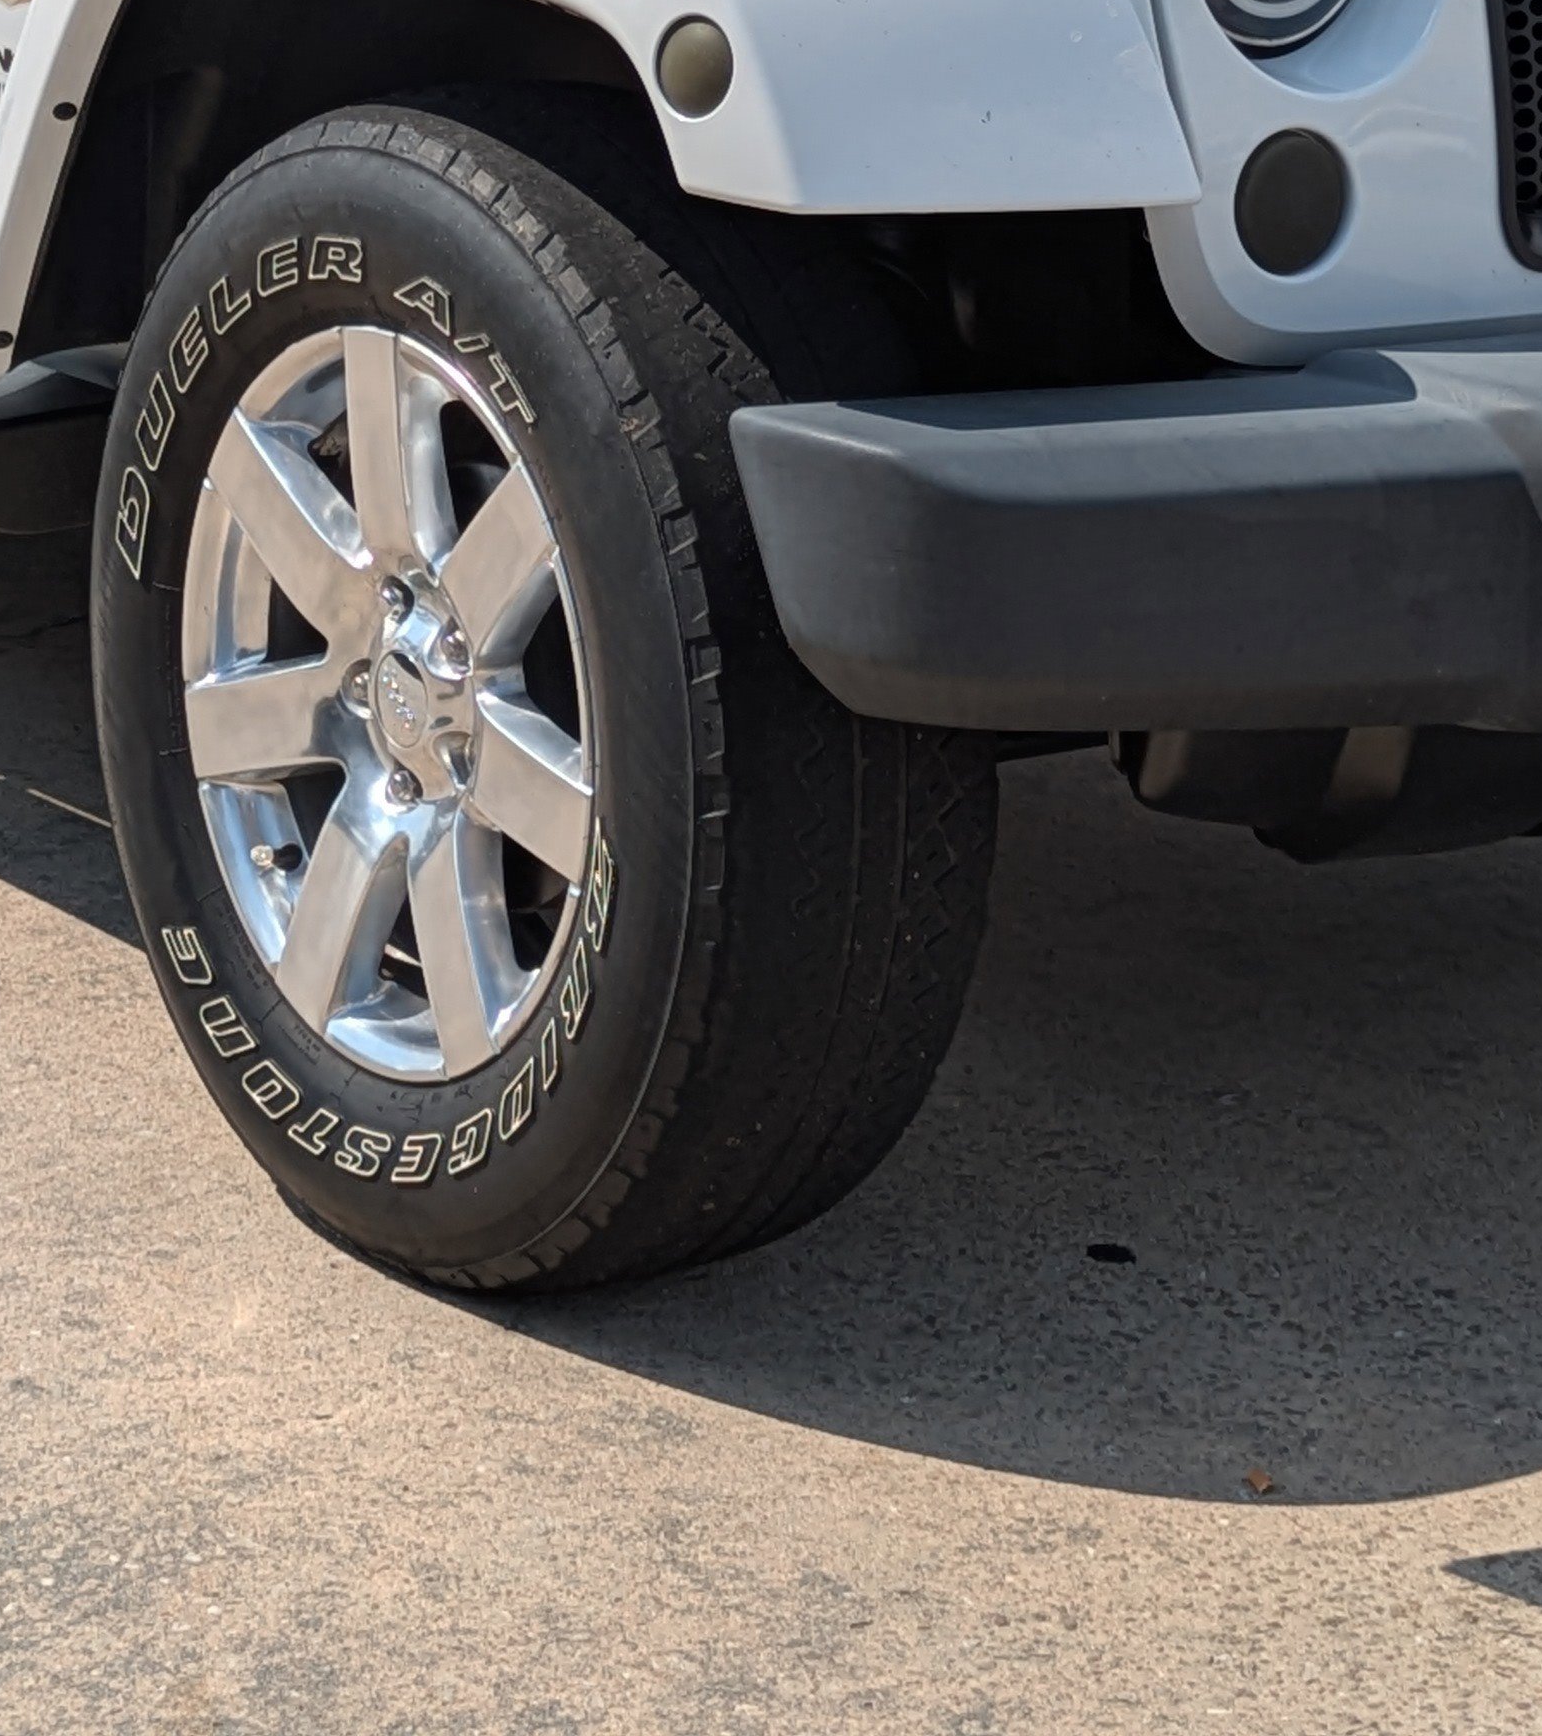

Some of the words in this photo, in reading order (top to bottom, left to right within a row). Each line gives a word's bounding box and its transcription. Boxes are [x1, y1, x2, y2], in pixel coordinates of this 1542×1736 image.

[115, 237, 362, 581] DUELER
[394, 276, 538, 427] A/T
[161, 816, 615, 1184] BRIDGESTONE
